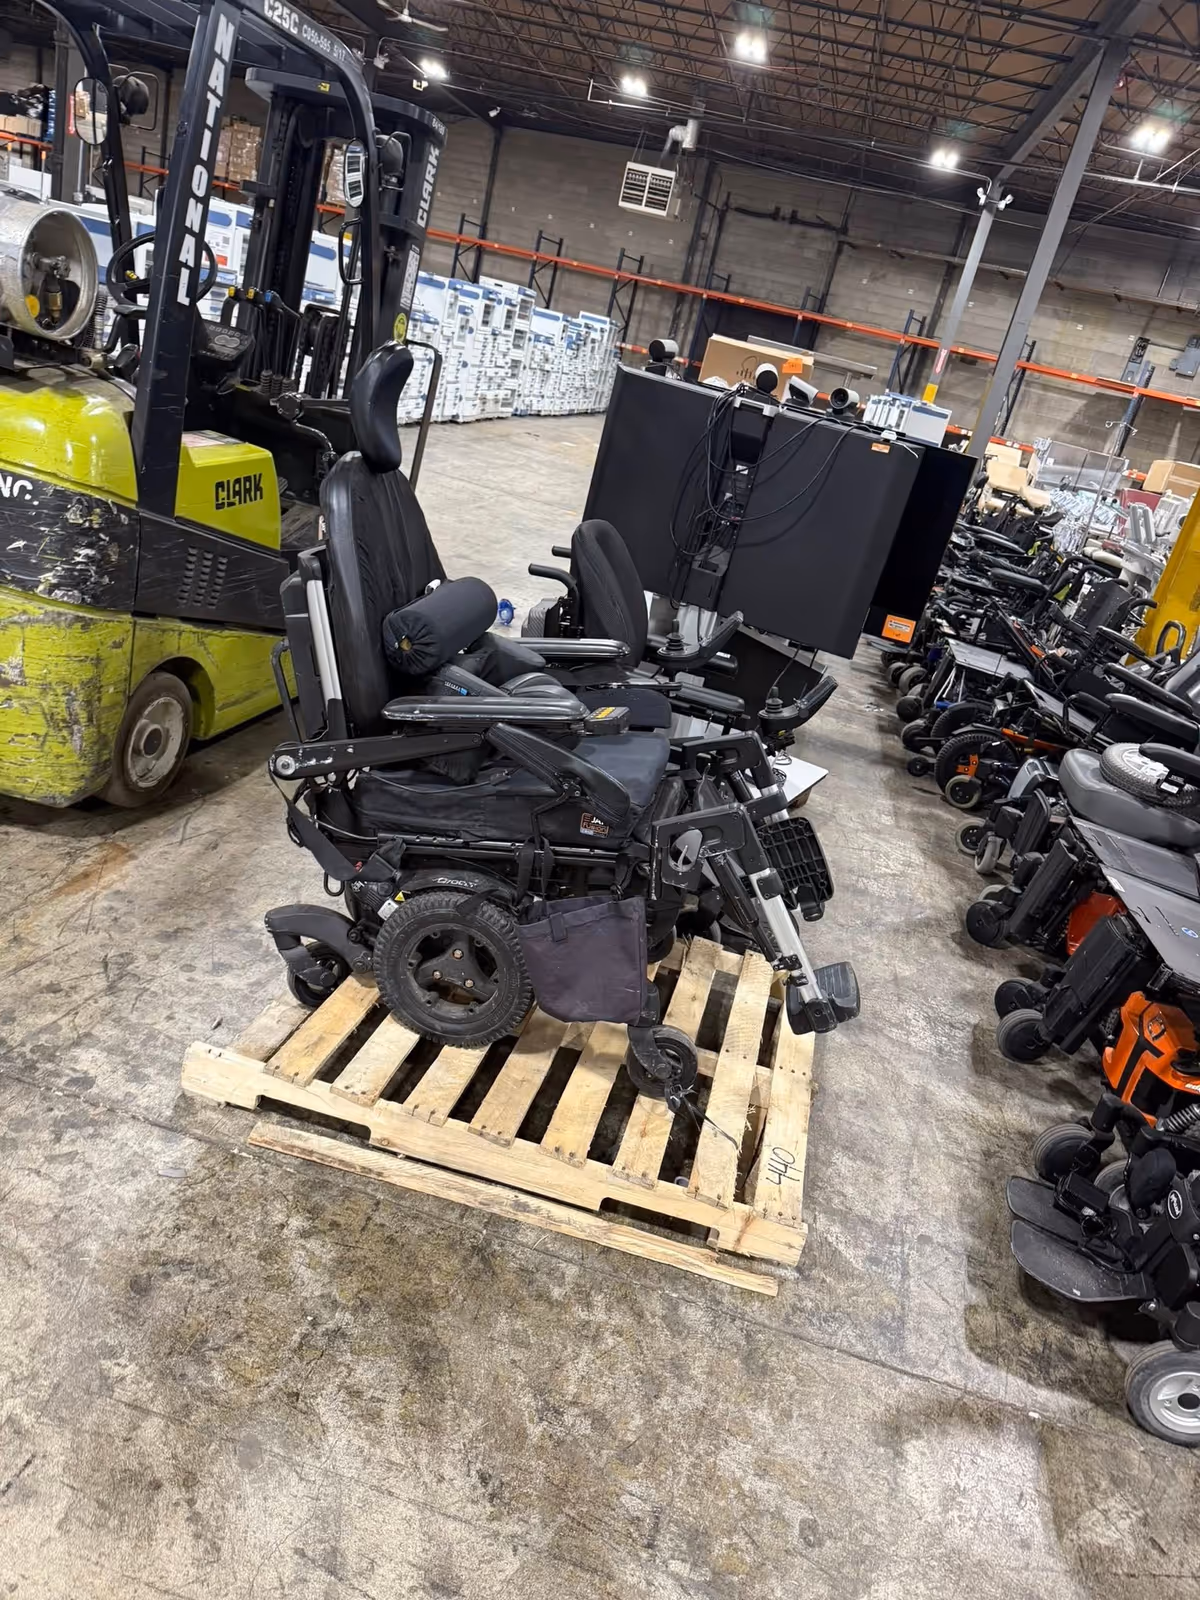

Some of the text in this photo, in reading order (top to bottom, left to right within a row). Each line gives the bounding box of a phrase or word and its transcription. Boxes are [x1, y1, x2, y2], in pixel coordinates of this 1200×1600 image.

[263, 0, 299, 34] C25C
[177, 13, 235, 306] NATIONAL
[416, 145, 440, 228] CLARK
[215, 472, 263, 511] CLARK
[765, 1146, 803, 1186] 440
